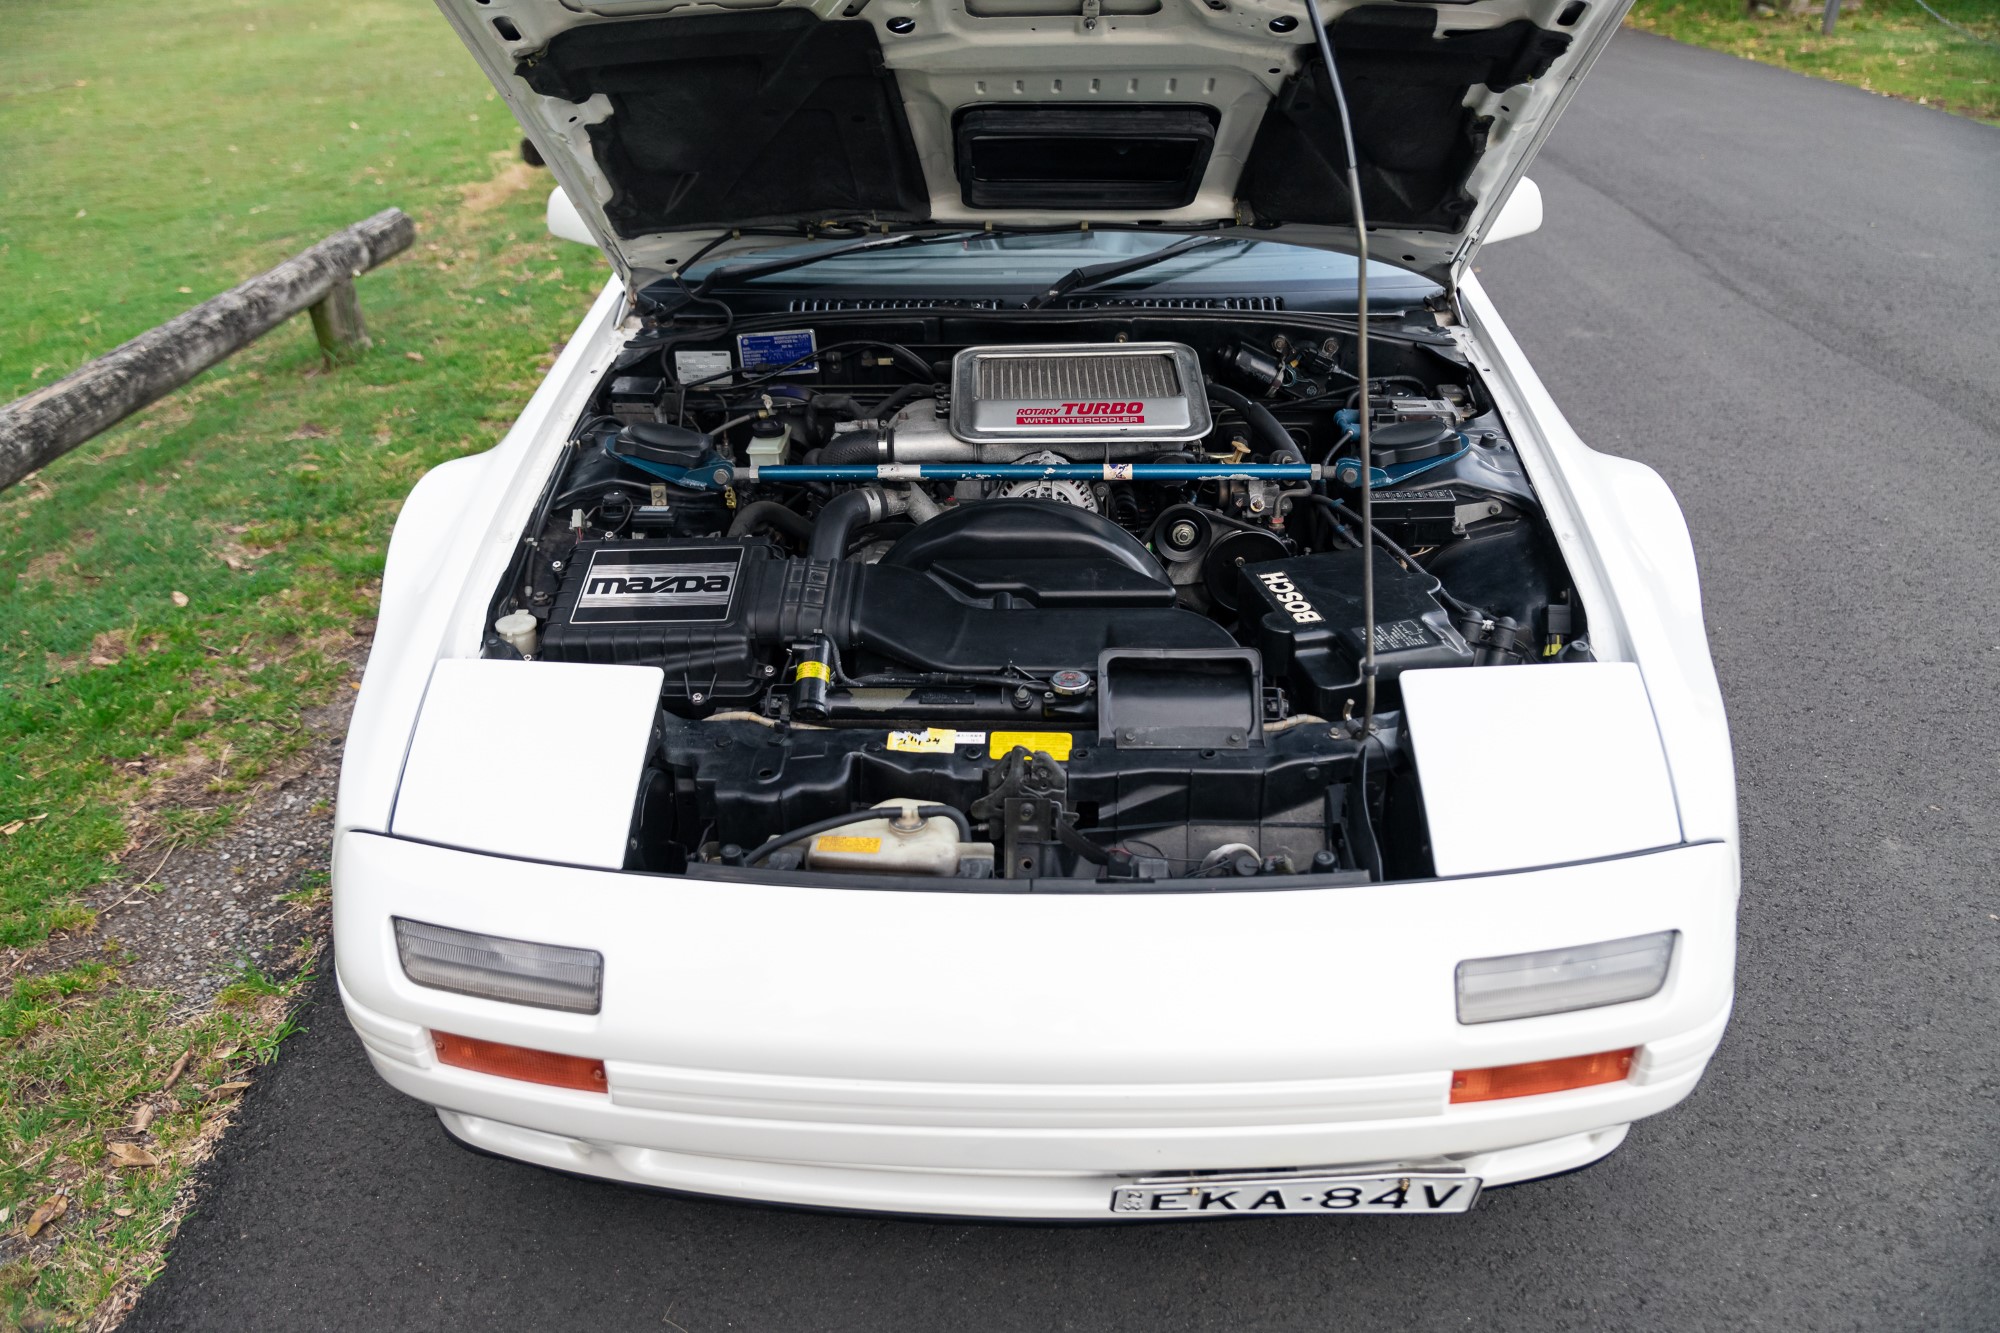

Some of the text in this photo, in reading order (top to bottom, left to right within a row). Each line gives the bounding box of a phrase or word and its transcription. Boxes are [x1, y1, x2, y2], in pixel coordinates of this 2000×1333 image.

[1016, 402, 1144, 416] ROTARY TURBO
[1057, 416, 1138, 424] INTERCOOLER
[587, 574, 731, 595] mazda
[1259, 571, 1323, 623] BOSCH
